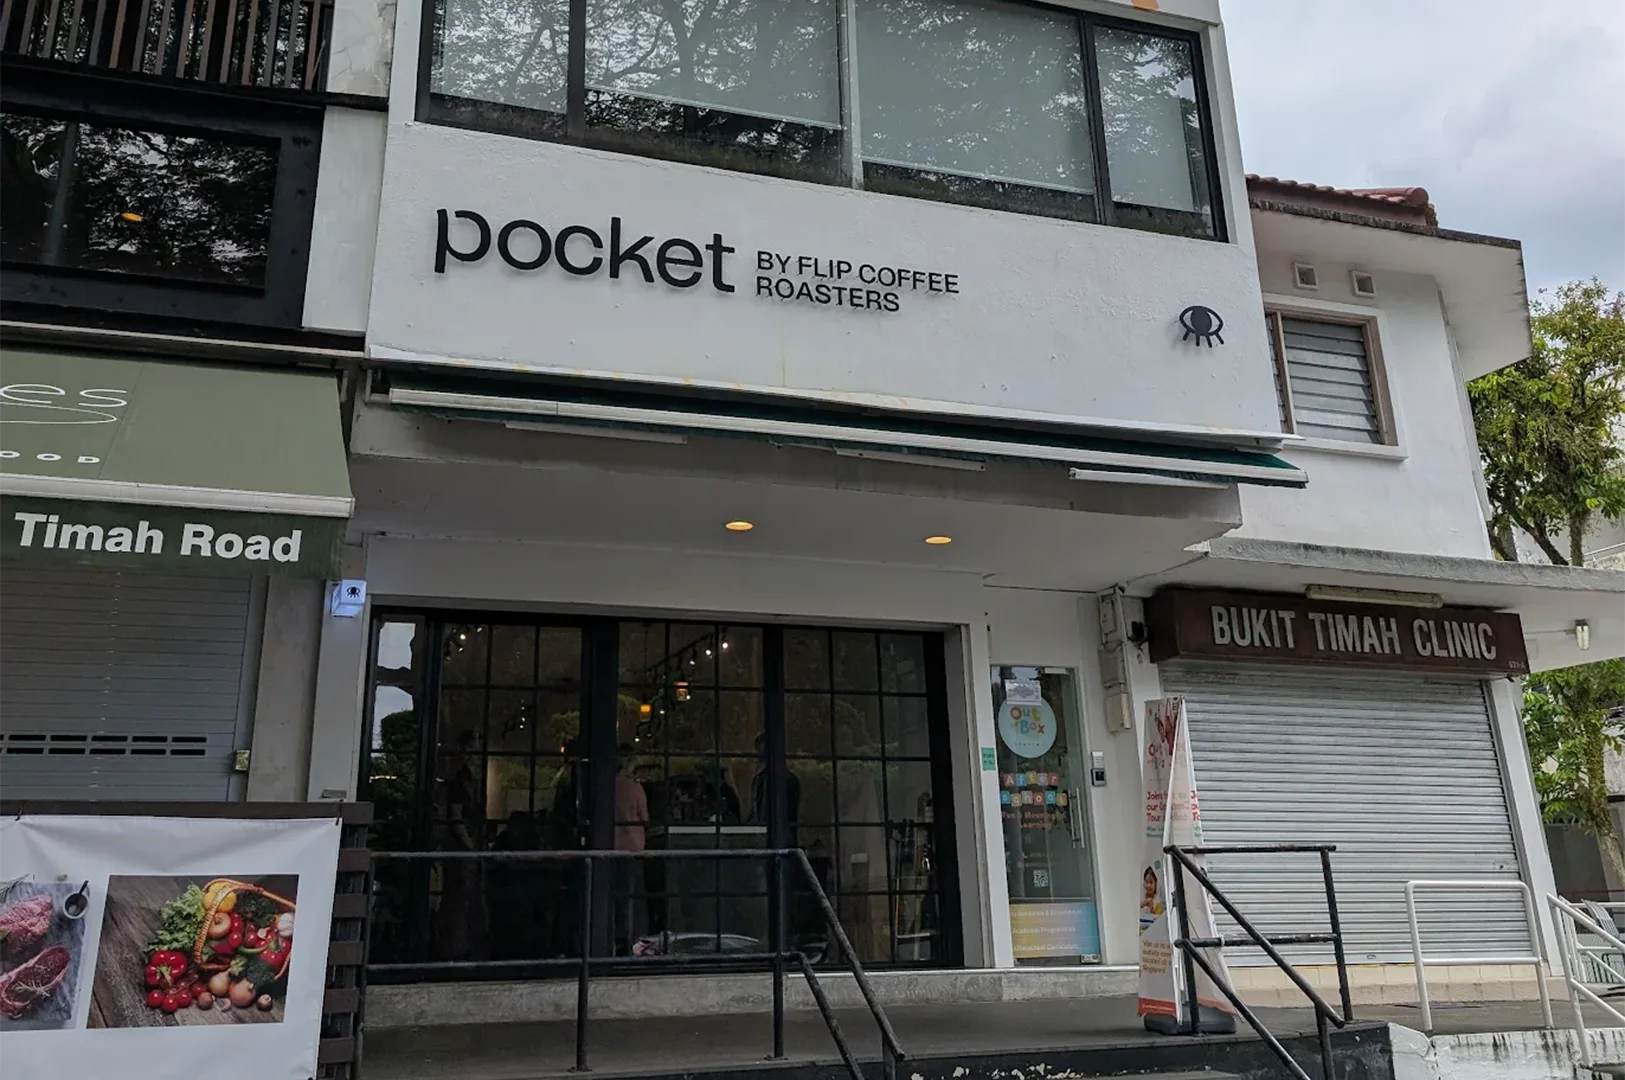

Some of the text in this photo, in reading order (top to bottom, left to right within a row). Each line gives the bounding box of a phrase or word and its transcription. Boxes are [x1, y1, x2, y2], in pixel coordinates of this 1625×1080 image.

[434, 208, 736, 293] pocket
[757, 250, 960, 295] BY FLIP COFFEE
[755, 275, 900, 312] ROASTERS
[15, 511, 302, 563] Timah Road
[1211, 604, 1497, 661] BUKIT TIMAH CLINIC
